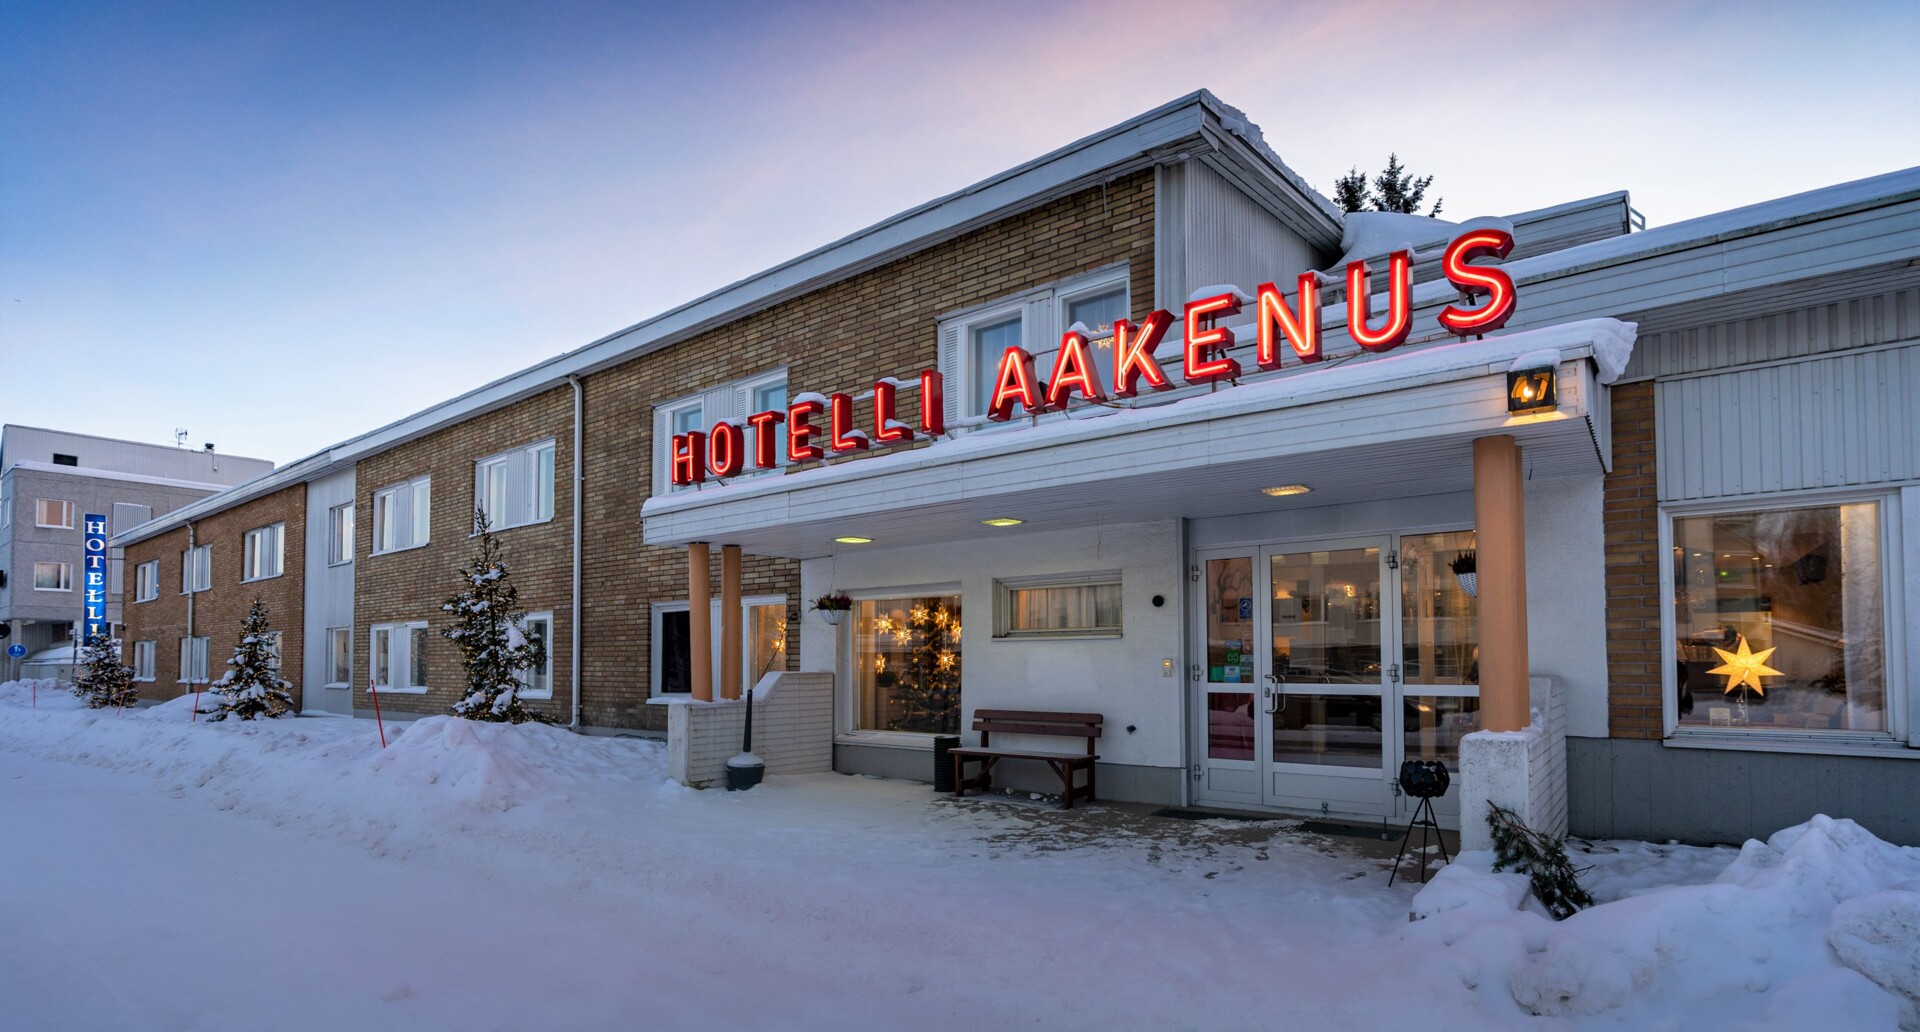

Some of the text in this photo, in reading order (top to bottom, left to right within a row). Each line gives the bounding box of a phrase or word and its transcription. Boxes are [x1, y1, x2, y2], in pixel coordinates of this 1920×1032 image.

[672, 229, 1517, 486] HOTELLI AAKENUS
[86, 521, 106, 637] HOTELLI
